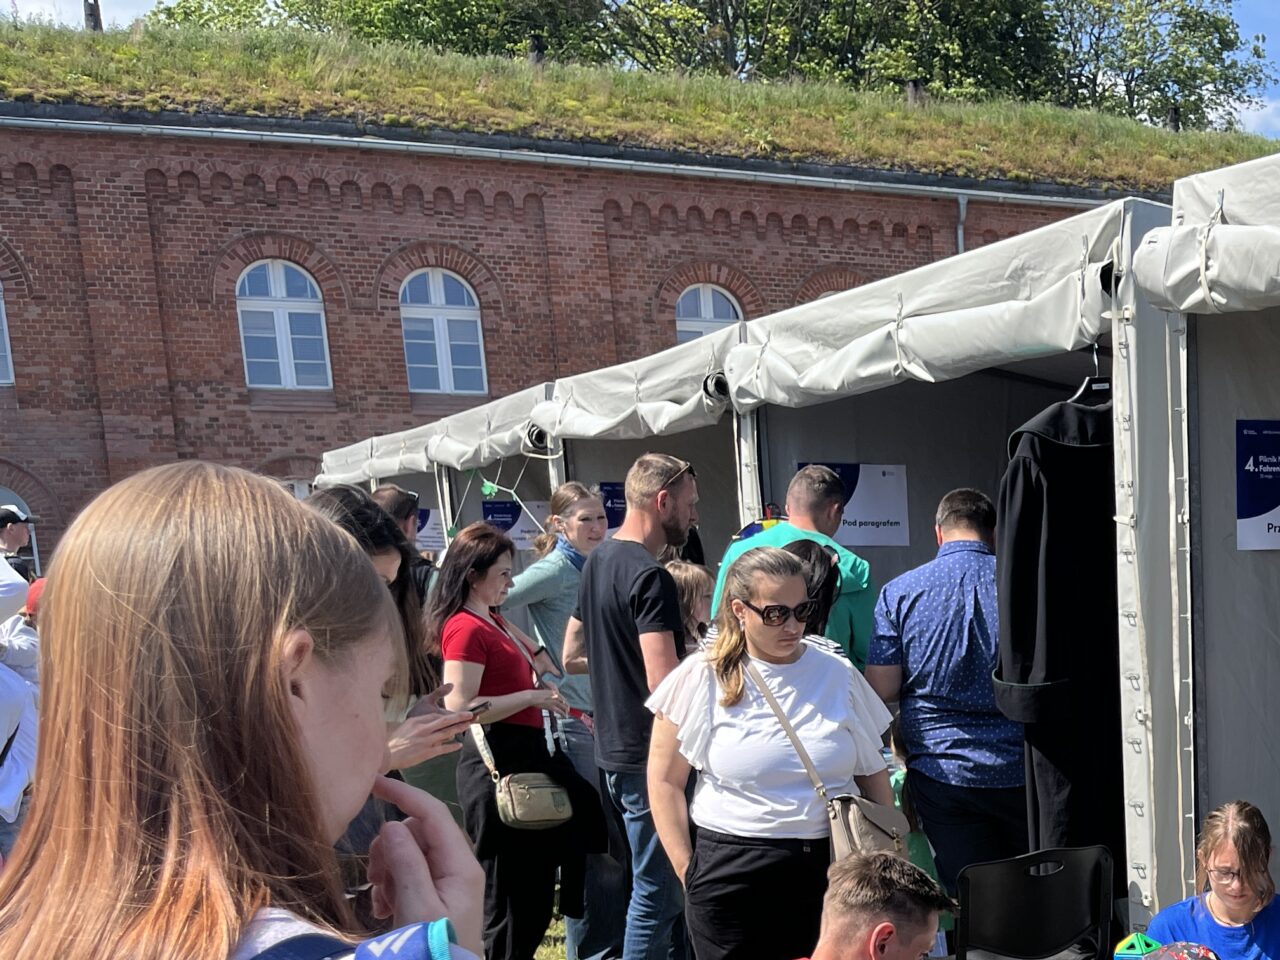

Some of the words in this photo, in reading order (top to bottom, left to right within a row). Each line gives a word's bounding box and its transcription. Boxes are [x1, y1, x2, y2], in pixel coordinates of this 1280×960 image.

[1244, 456, 1258, 472] 4.
[842, 519, 857, 527] Pod
[858, 519, 901, 529] paragrafem
